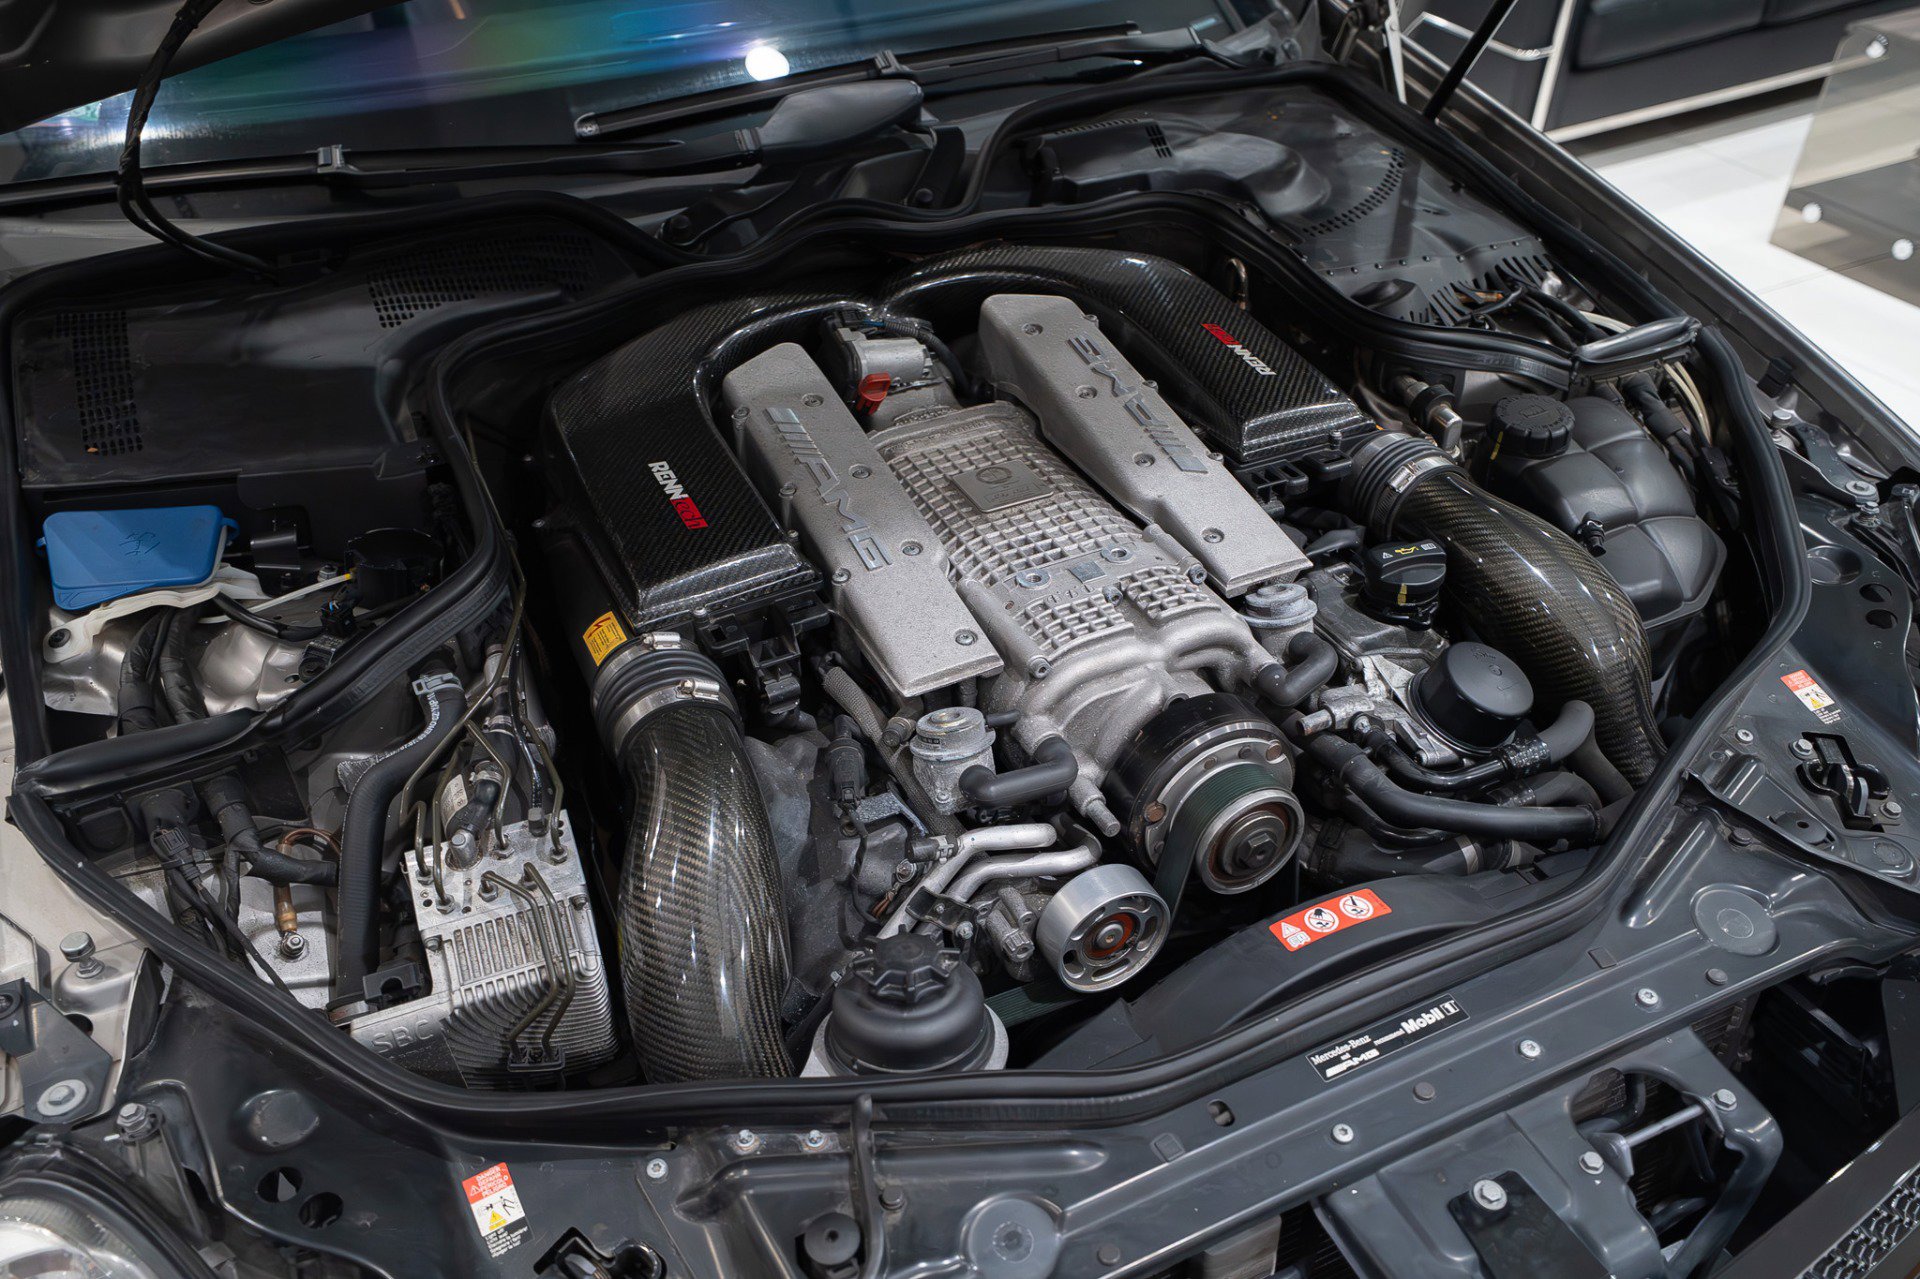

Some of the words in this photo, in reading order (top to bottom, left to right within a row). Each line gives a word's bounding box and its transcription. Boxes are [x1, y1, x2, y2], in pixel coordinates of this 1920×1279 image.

[794, 452, 893, 572] AMG
[371, 1019, 434, 1054] SBC
[1401, 1007, 1446, 1035] Mobil
[1310, 1034, 1371, 1065] Mercedes-Benz
